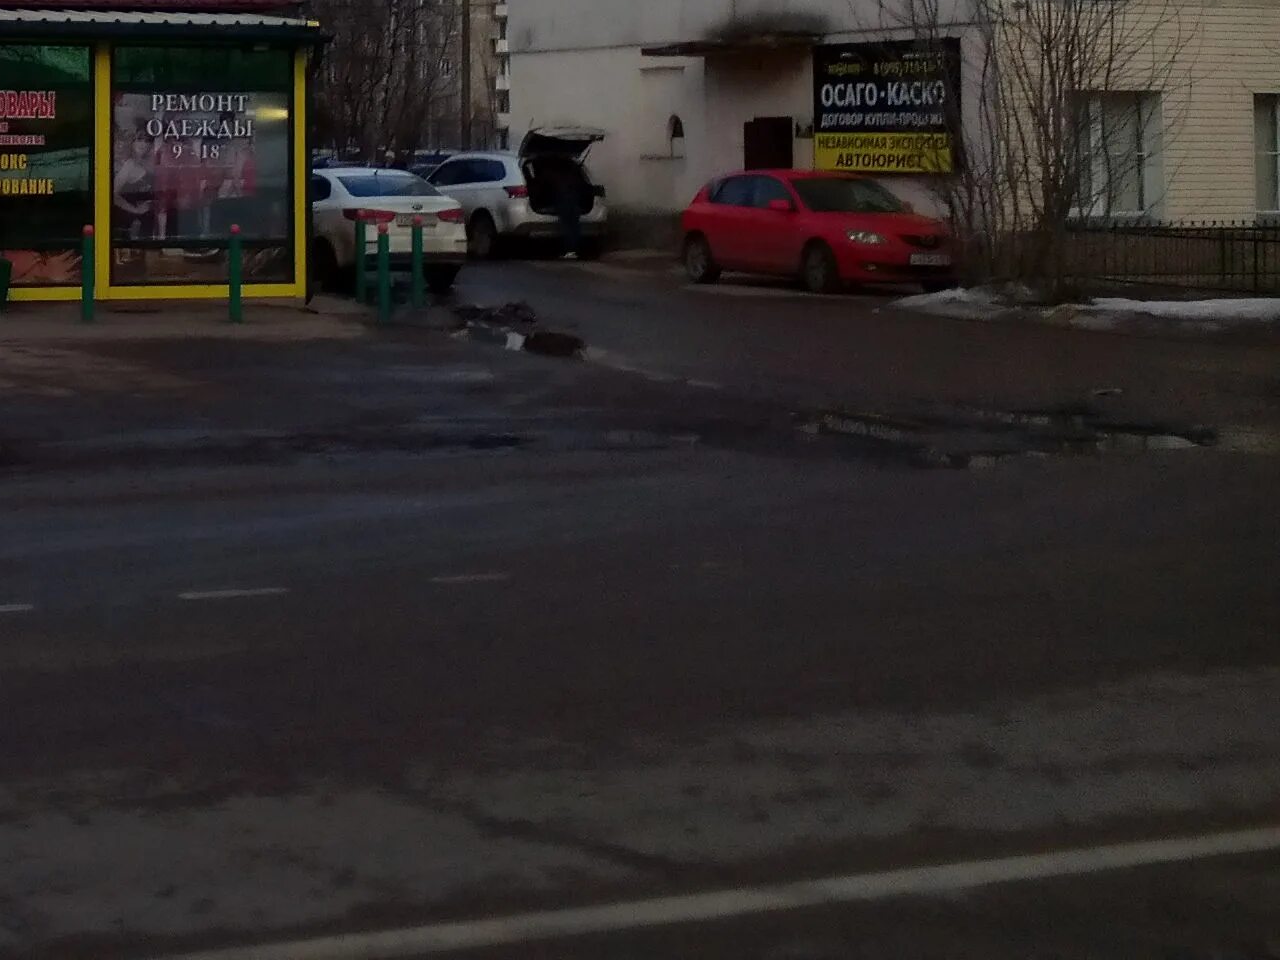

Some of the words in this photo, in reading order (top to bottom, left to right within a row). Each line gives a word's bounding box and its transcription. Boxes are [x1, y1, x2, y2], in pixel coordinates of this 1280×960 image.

[152, 94, 249, 115] РЕМОНТ
[820, 112, 864, 129] ДОГОВОР
[147, 120, 254, 141] ОДЕЖДЫ
[0, 134, 46, 146] школы
[817, 136, 887, 150] НЕЗАВИСИМАЯ
[172, 144, 183, 160] 9
[835, 153, 925, 169] АВТОЮРИСТ
